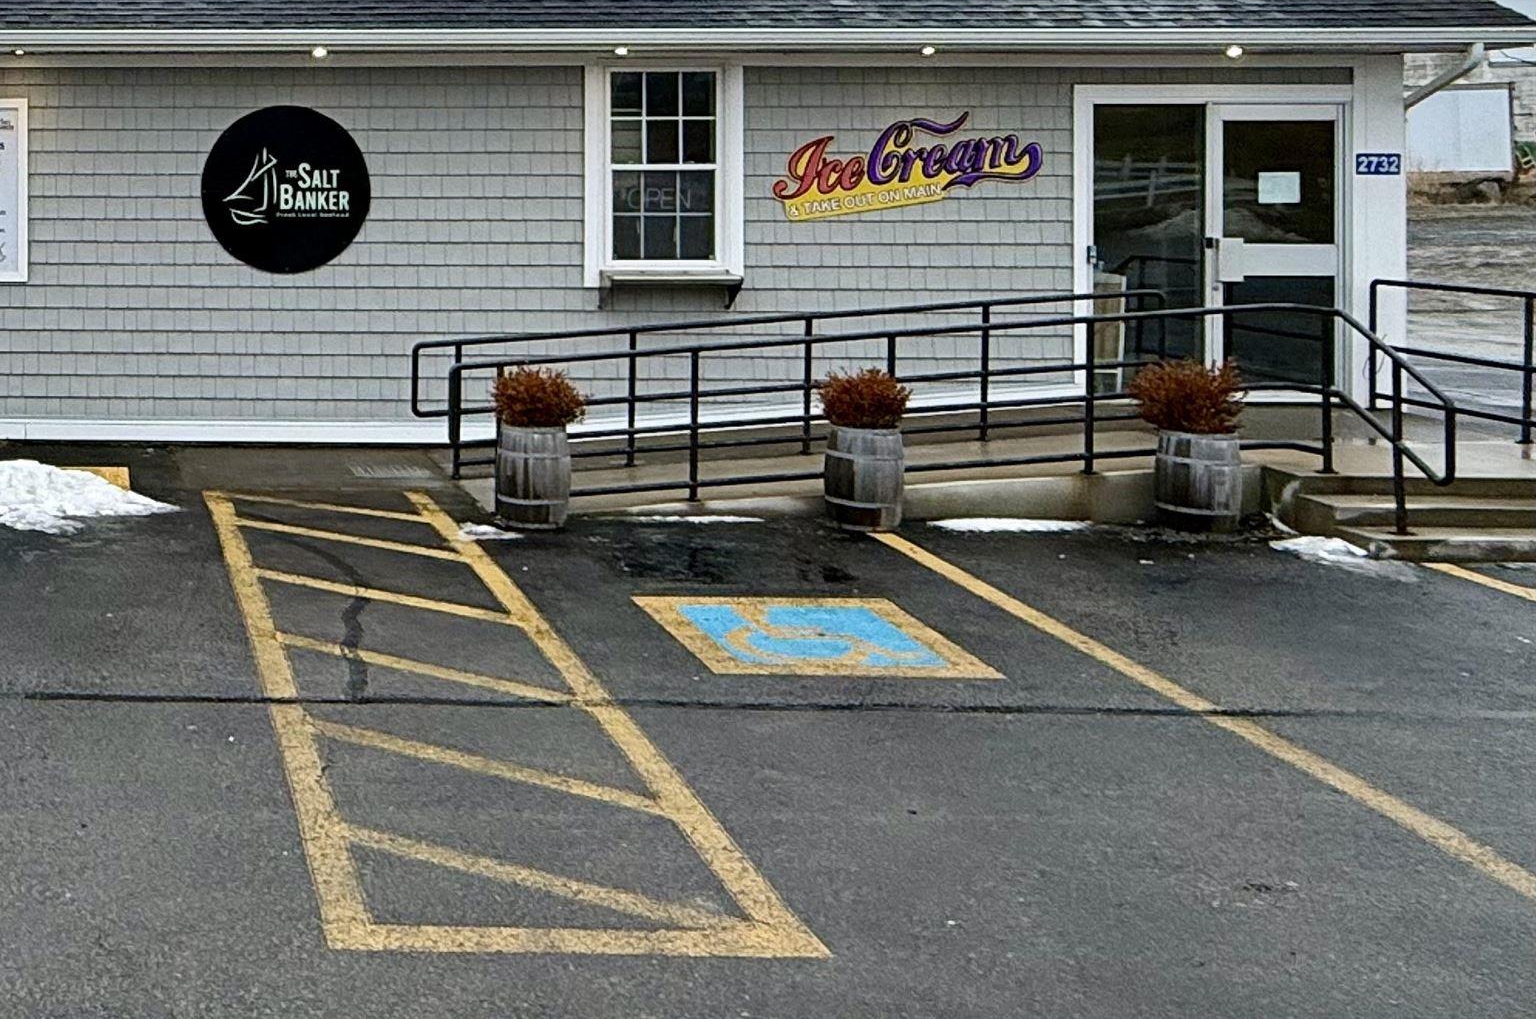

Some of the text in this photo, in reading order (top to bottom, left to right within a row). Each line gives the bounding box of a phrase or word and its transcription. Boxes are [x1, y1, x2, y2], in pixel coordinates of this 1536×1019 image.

[772, 111, 1043, 200] Ice Cream
[1357, 156, 1400, 173] 2732
[297, 162, 340, 189] SALT
[280, 183, 350, 211] BANKER
[627, 188, 691, 210] OPEN
[804, 199, 842, 215] TAKE
[842, 193, 875, 210] OUT
[878, 189, 901, 203] ON
[904, 183, 943, 200] MAIN
